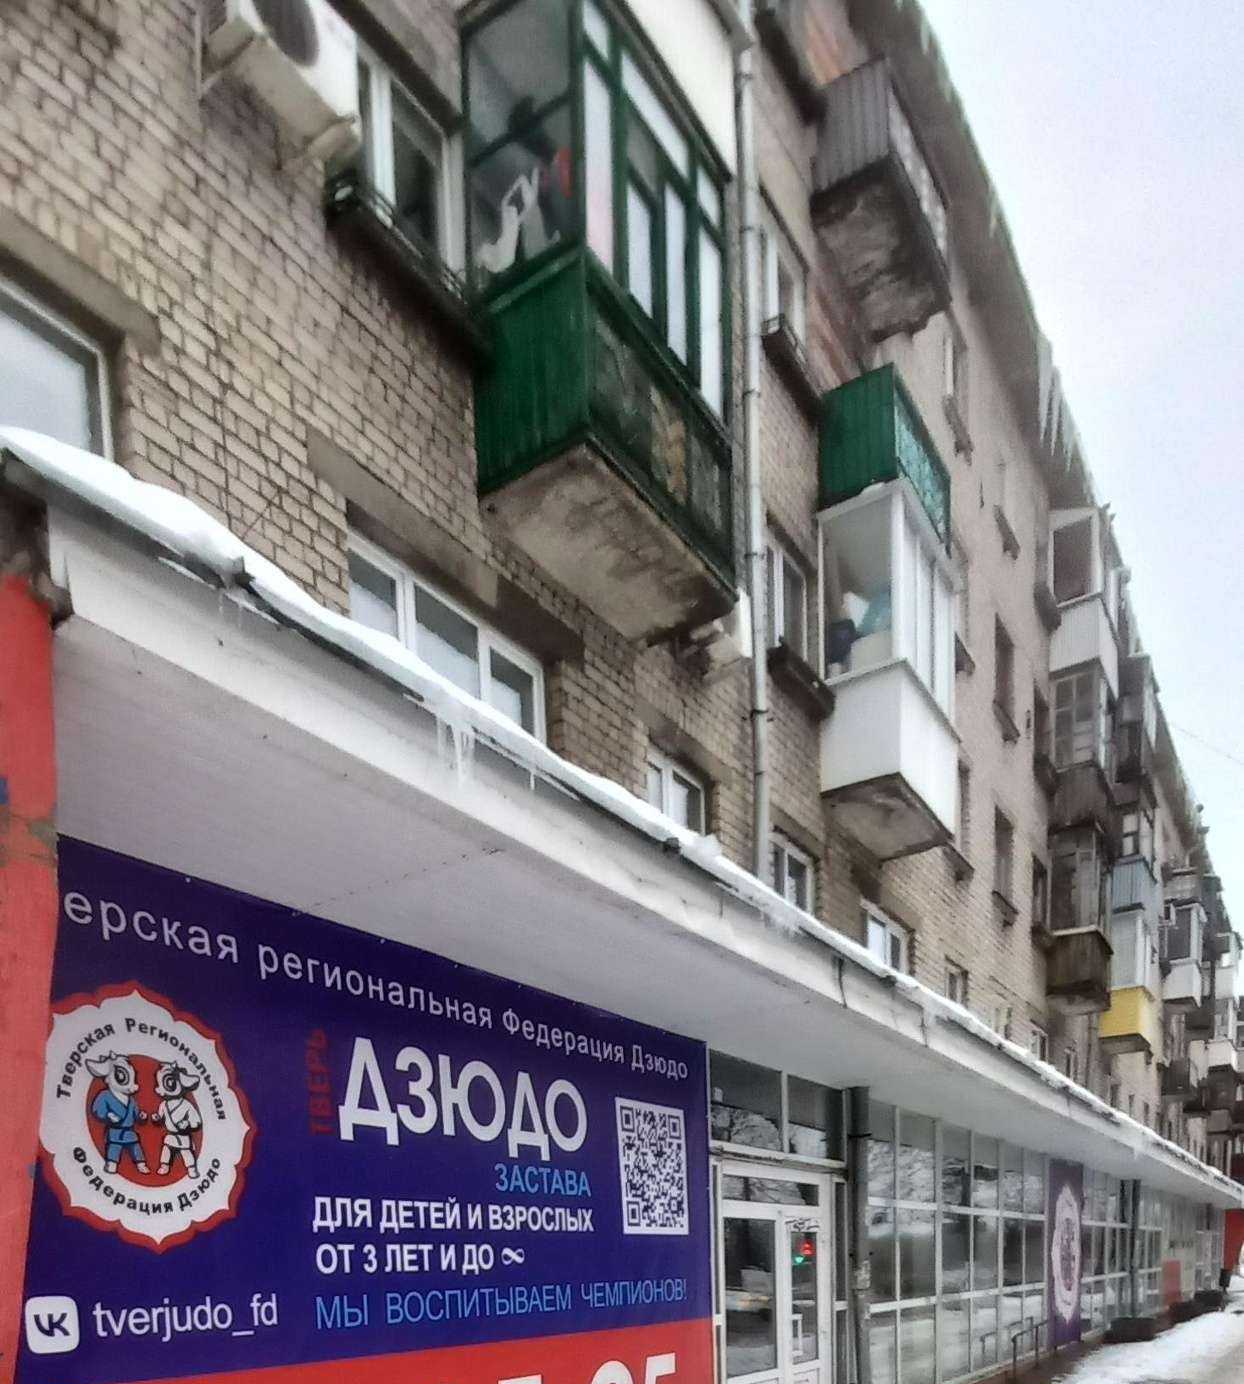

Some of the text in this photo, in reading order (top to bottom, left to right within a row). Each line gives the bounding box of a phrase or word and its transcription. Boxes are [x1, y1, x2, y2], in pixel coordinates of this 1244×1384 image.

[257, 944, 493, 1029] региональная
[502, 1008, 625, 1064] Федерация
[631, 1044, 688, 1081] Дзюдо
[56, 1018, 226, 1120] Тверская Региональная
[304, 1027, 335, 1136] ТВЕРЬ
[338, 1036, 588, 1161] ДЗЮДО
[73, 1146, 221, 1215] Федерация Дзюдо
[494, 1162, 592, 1197] ЗАСТАВА
[312, 1196, 594, 1234] ДЛЯ ДЕТЕЙ И ВЗРОСЛЫХ
[315, 1243, 355, 1274] ОТ
[362, 1243, 378, 1274] 3
[384, 1244, 434, 1272] ЛЕТ
[439, 1244, 457, 1271] И
[462, 1244, 495, 1276] ДО
[92, 1292, 279, 1342] tverjudo_fd
[315, 1278, 688, 1329] МЫ ВОСПИТЫВАЕМ ЧЕМПИОНОВ!
